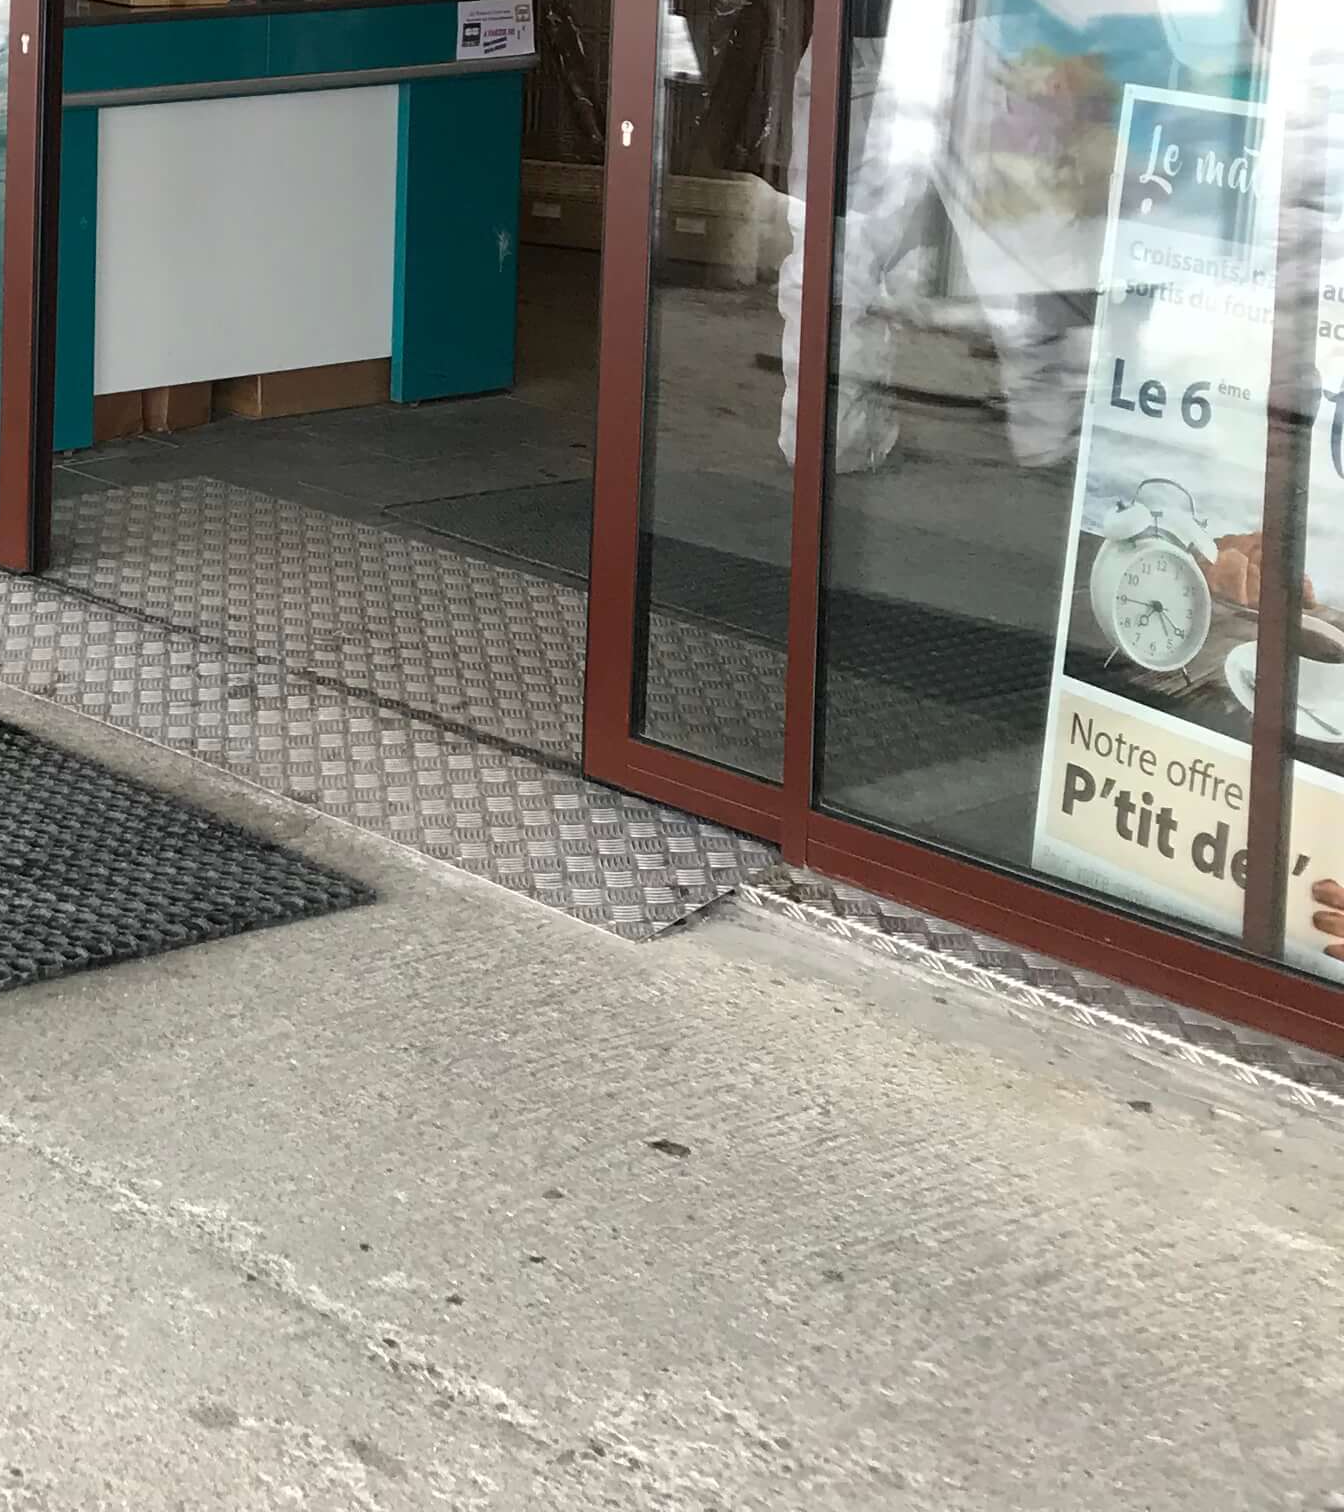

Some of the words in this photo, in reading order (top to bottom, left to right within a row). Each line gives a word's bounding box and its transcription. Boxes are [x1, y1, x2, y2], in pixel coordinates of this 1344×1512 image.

[1111, 358, 1167, 419] Le
[1069, 712, 1157, 776] Notre
[1166, 757, 1245, 811] offre
[1061, 763, 1179, 859] P'tit
